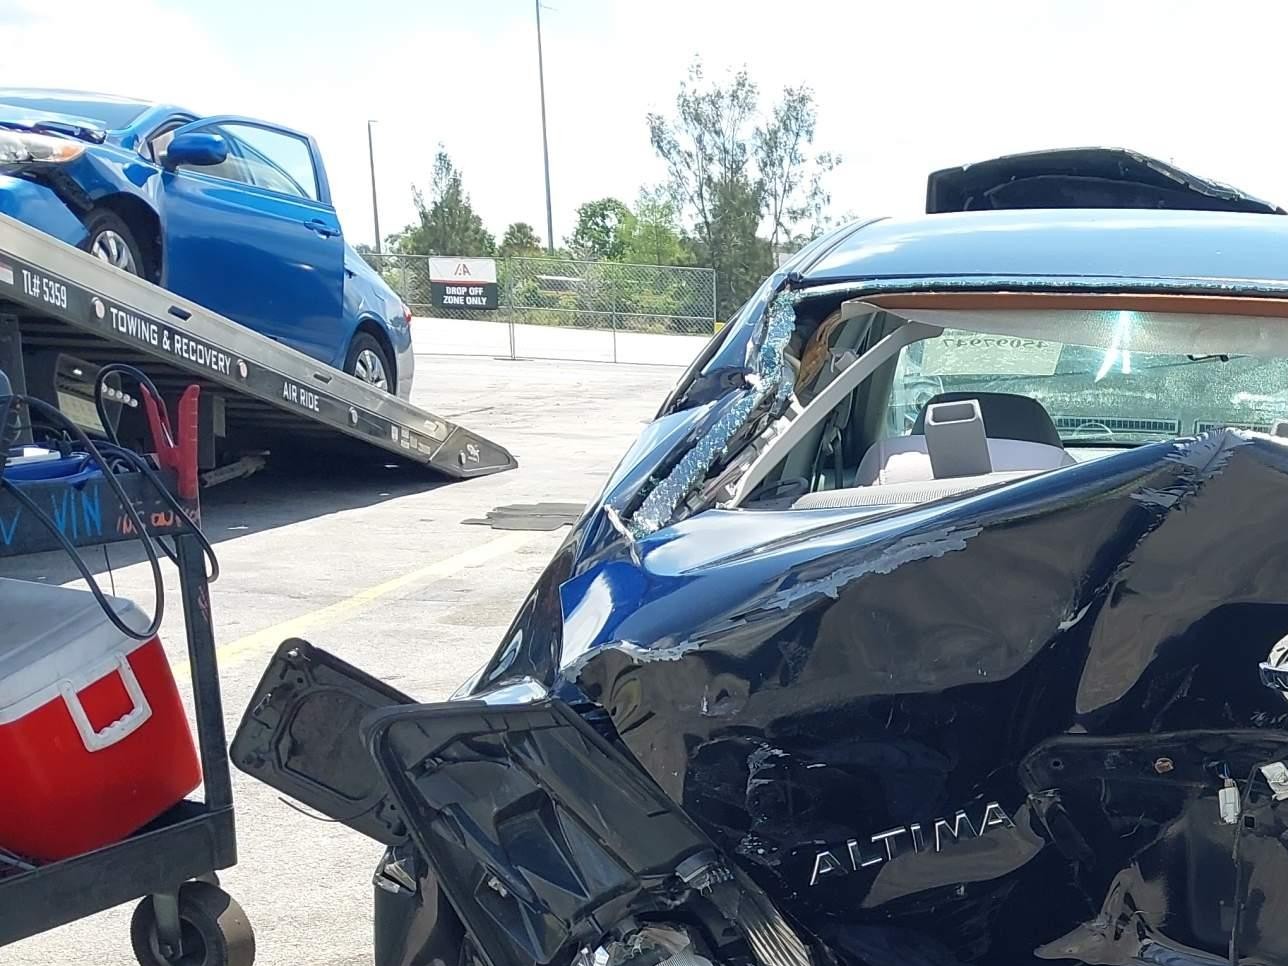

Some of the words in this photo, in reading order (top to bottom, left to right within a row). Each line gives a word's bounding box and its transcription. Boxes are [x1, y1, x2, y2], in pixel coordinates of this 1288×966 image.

[22, 269, 41, 298] TL#
[43, 278, 67, 309] 5359
[443, 295, 465, 305] ZONE
[465, 296, 487, 305] ONLY
[445, 286, 468, 296] DROP
[468, 287, 484, 296] OFF
[110, 307, 158, 346] TOWING
[162, 330, 171, 352] &
[174, 334, 232, 376] RECOVERY
[283, 381, 298, 403] AIR
[300, 388, 320, 412] RIDE
[51, 483, 103, 540] VIN
[809, 801, 1017, 887] ALTIMA
